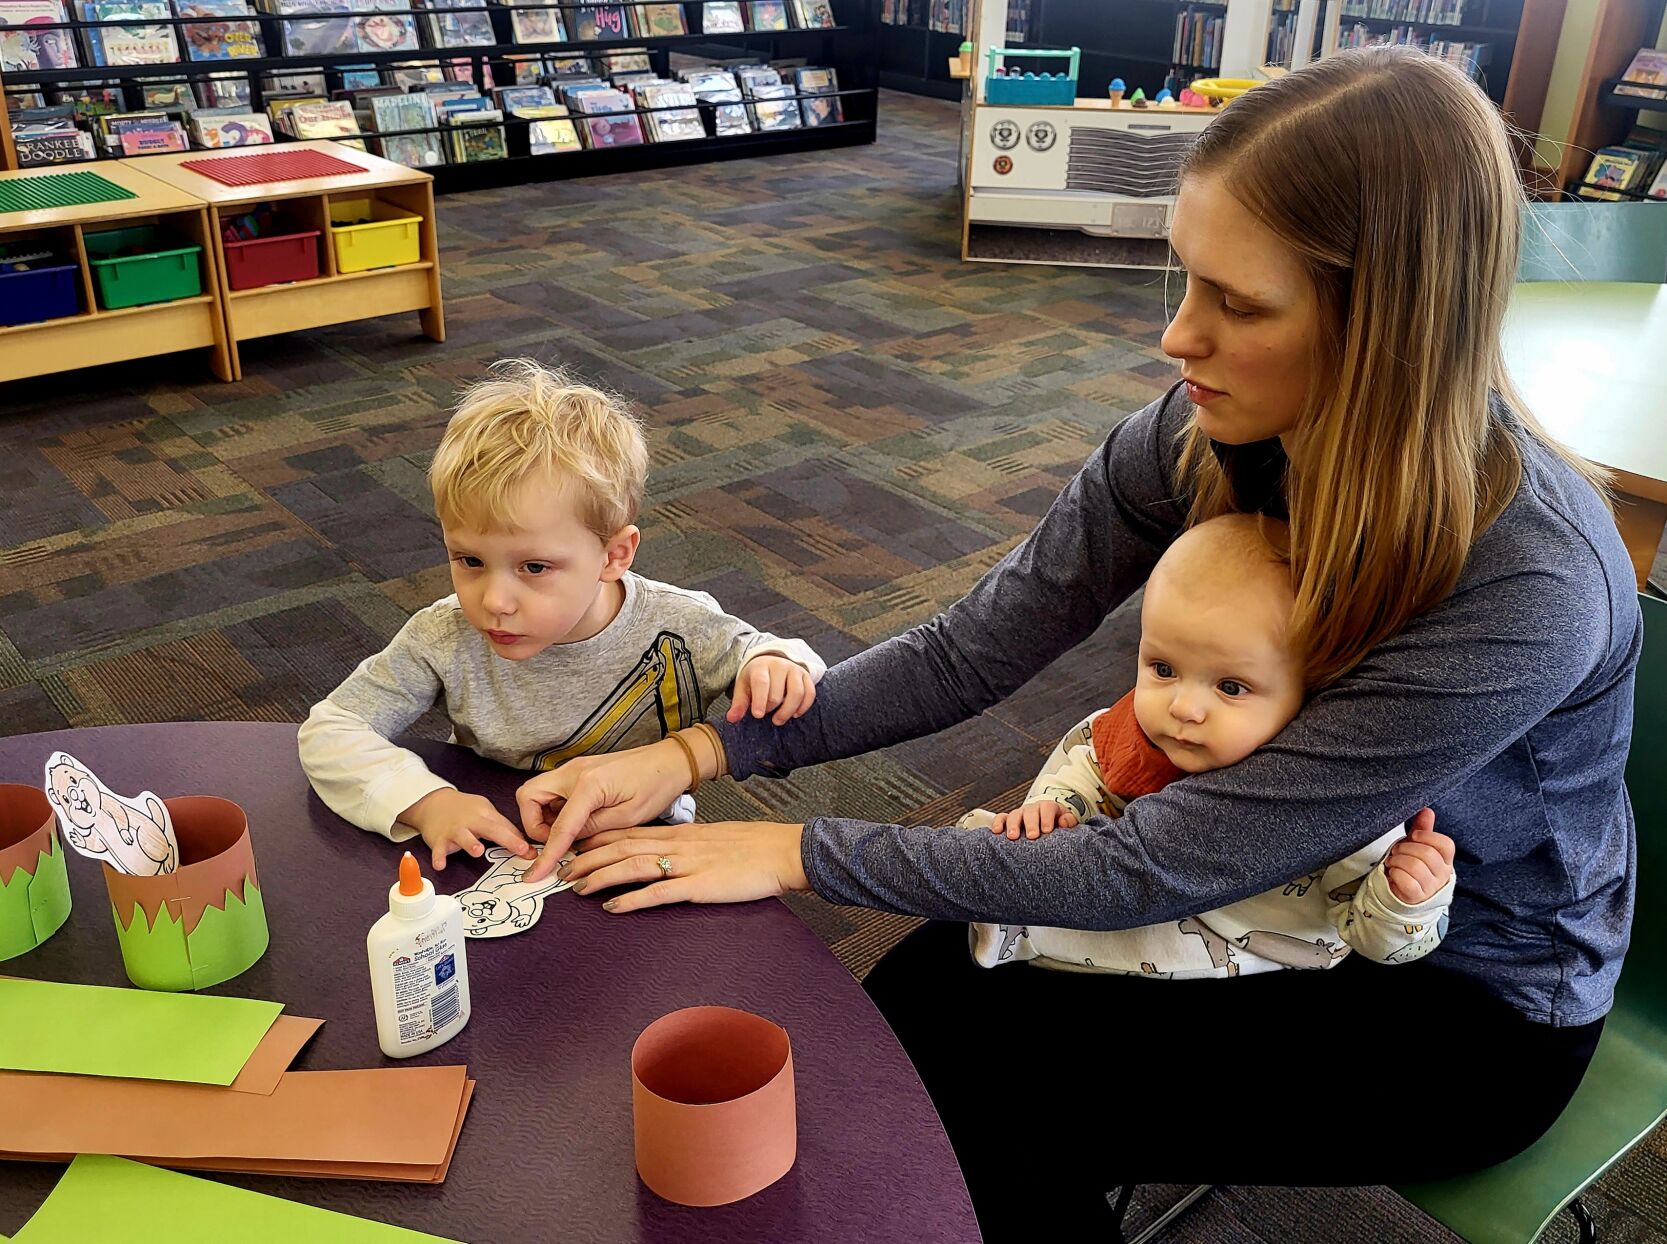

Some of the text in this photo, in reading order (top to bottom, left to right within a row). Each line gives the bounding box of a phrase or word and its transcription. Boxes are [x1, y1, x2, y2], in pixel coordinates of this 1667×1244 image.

[594, 7, 621, 33] Hug
[20, 148, 82, 162] DOODLE
[414, 950, 435, 962] School
